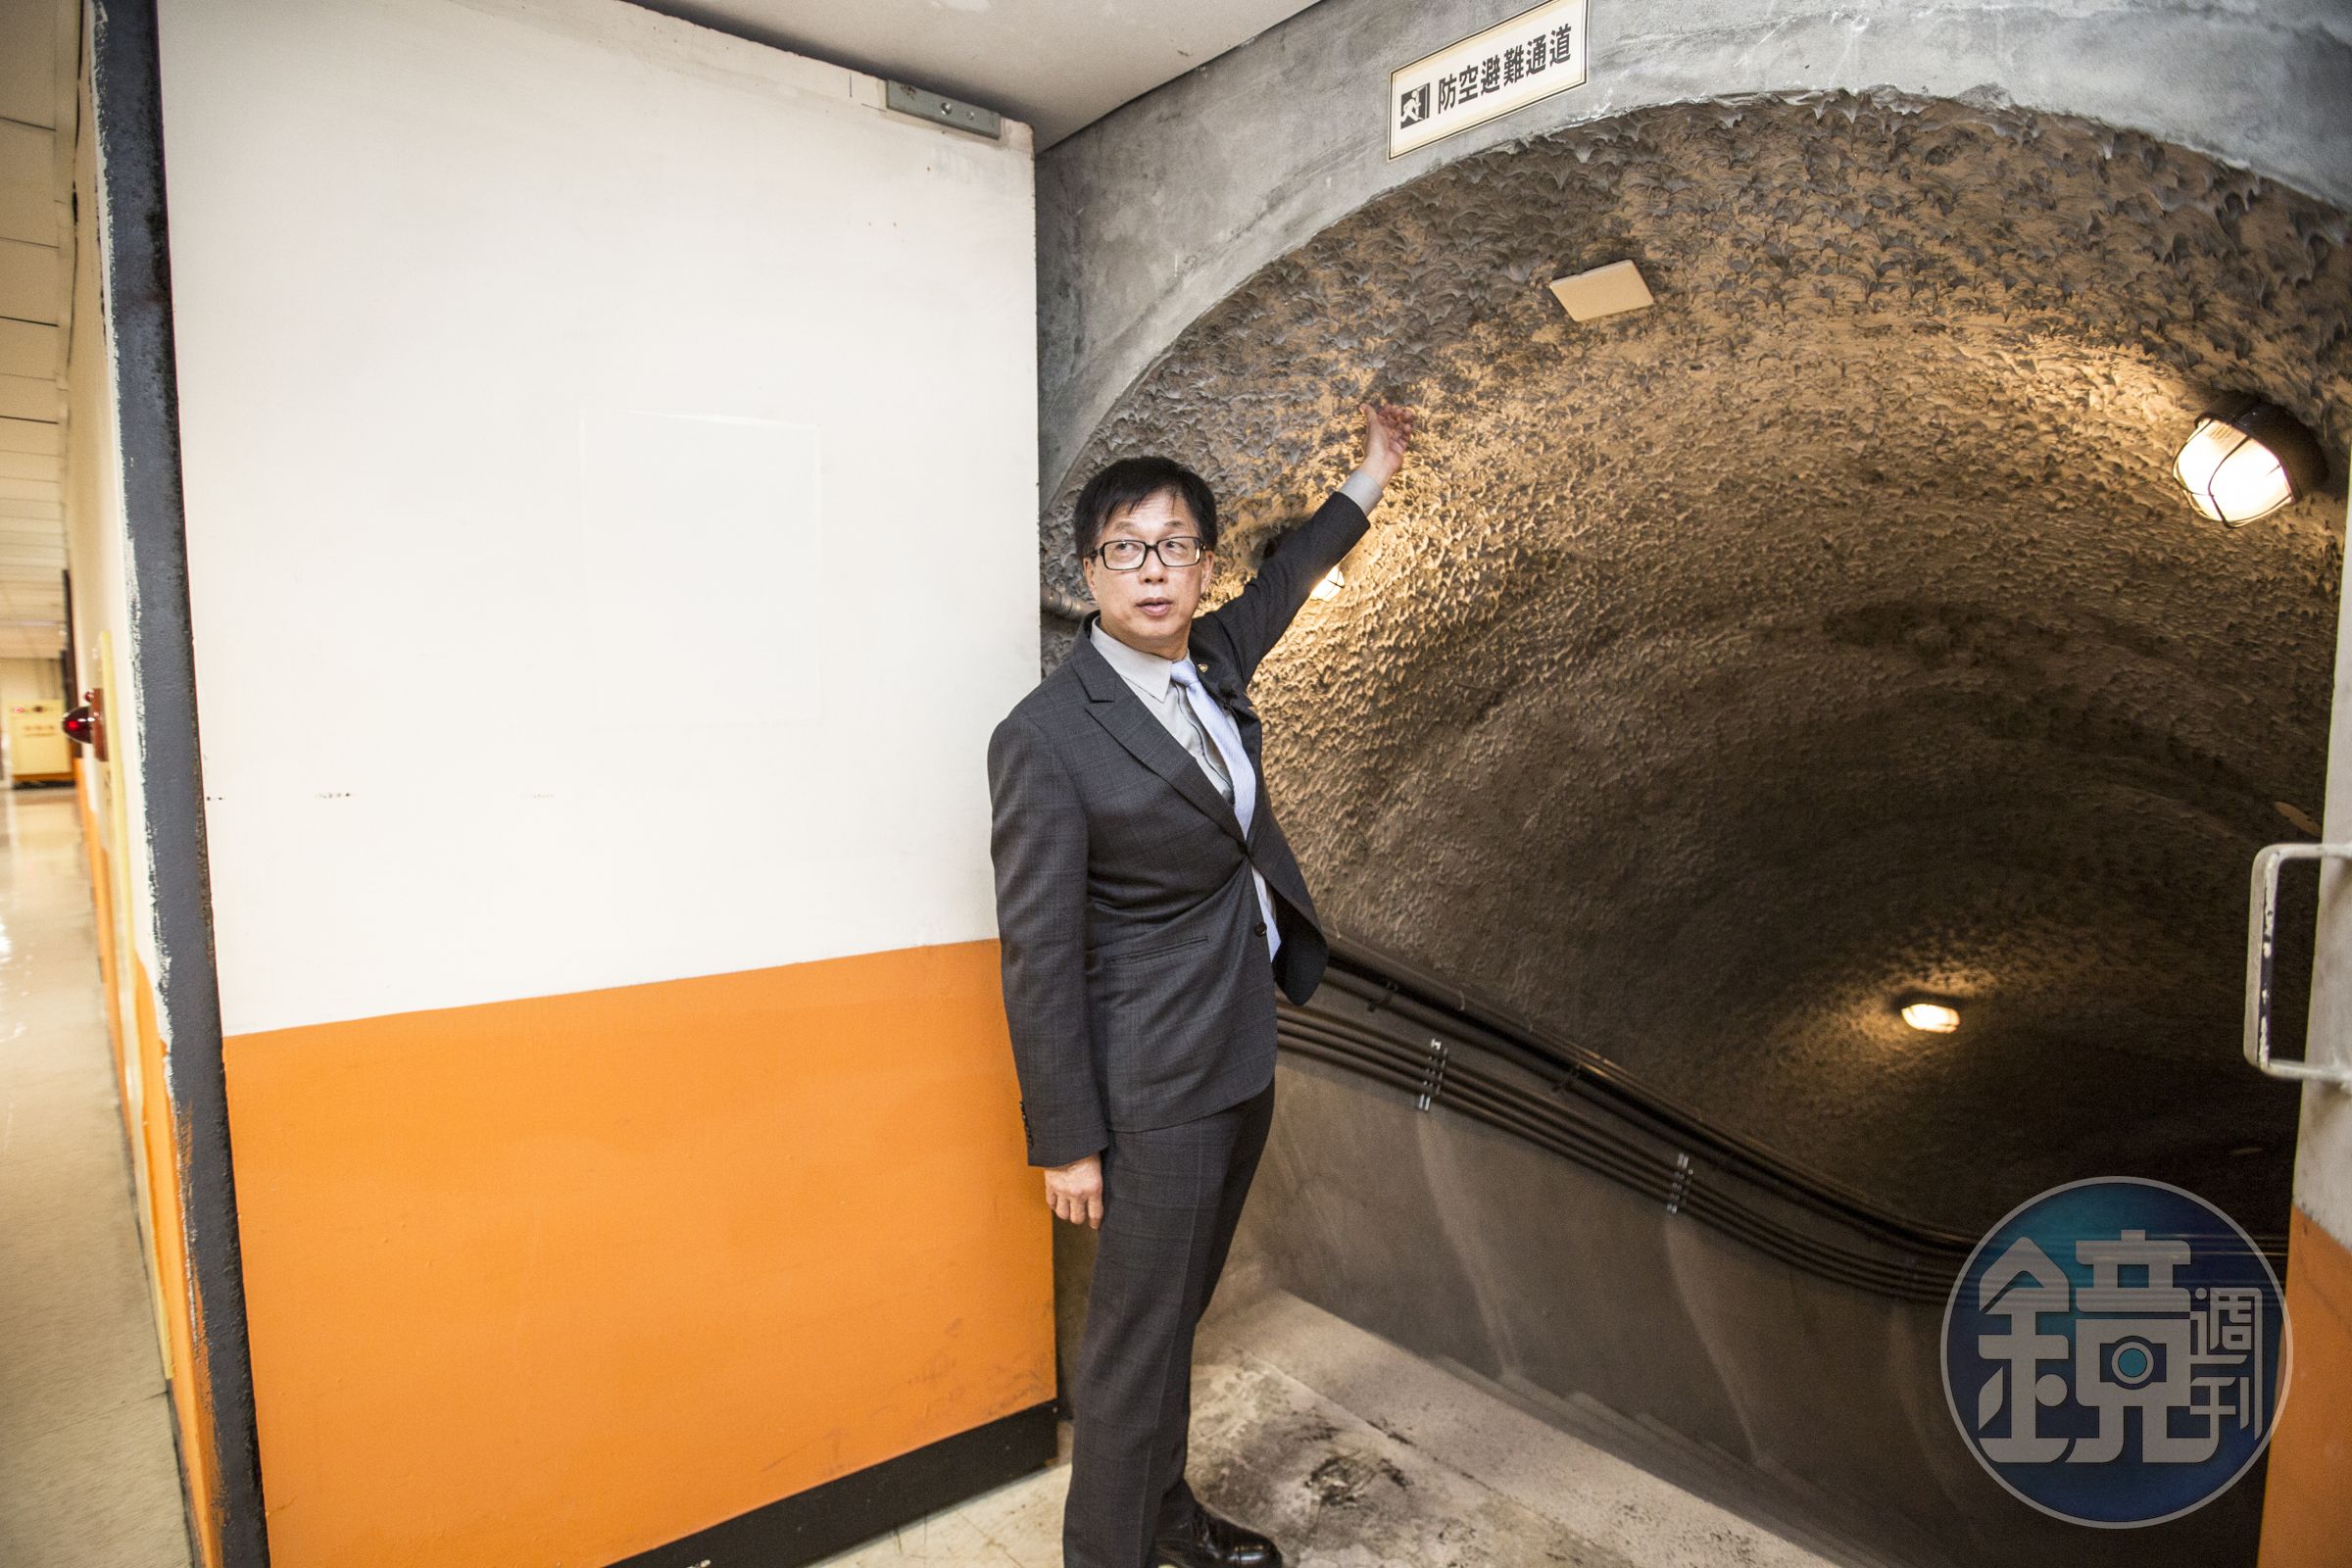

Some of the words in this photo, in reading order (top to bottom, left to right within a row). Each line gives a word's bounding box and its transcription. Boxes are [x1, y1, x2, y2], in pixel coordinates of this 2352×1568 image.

[1438, 24, 1572, 114] 防空避難通道
